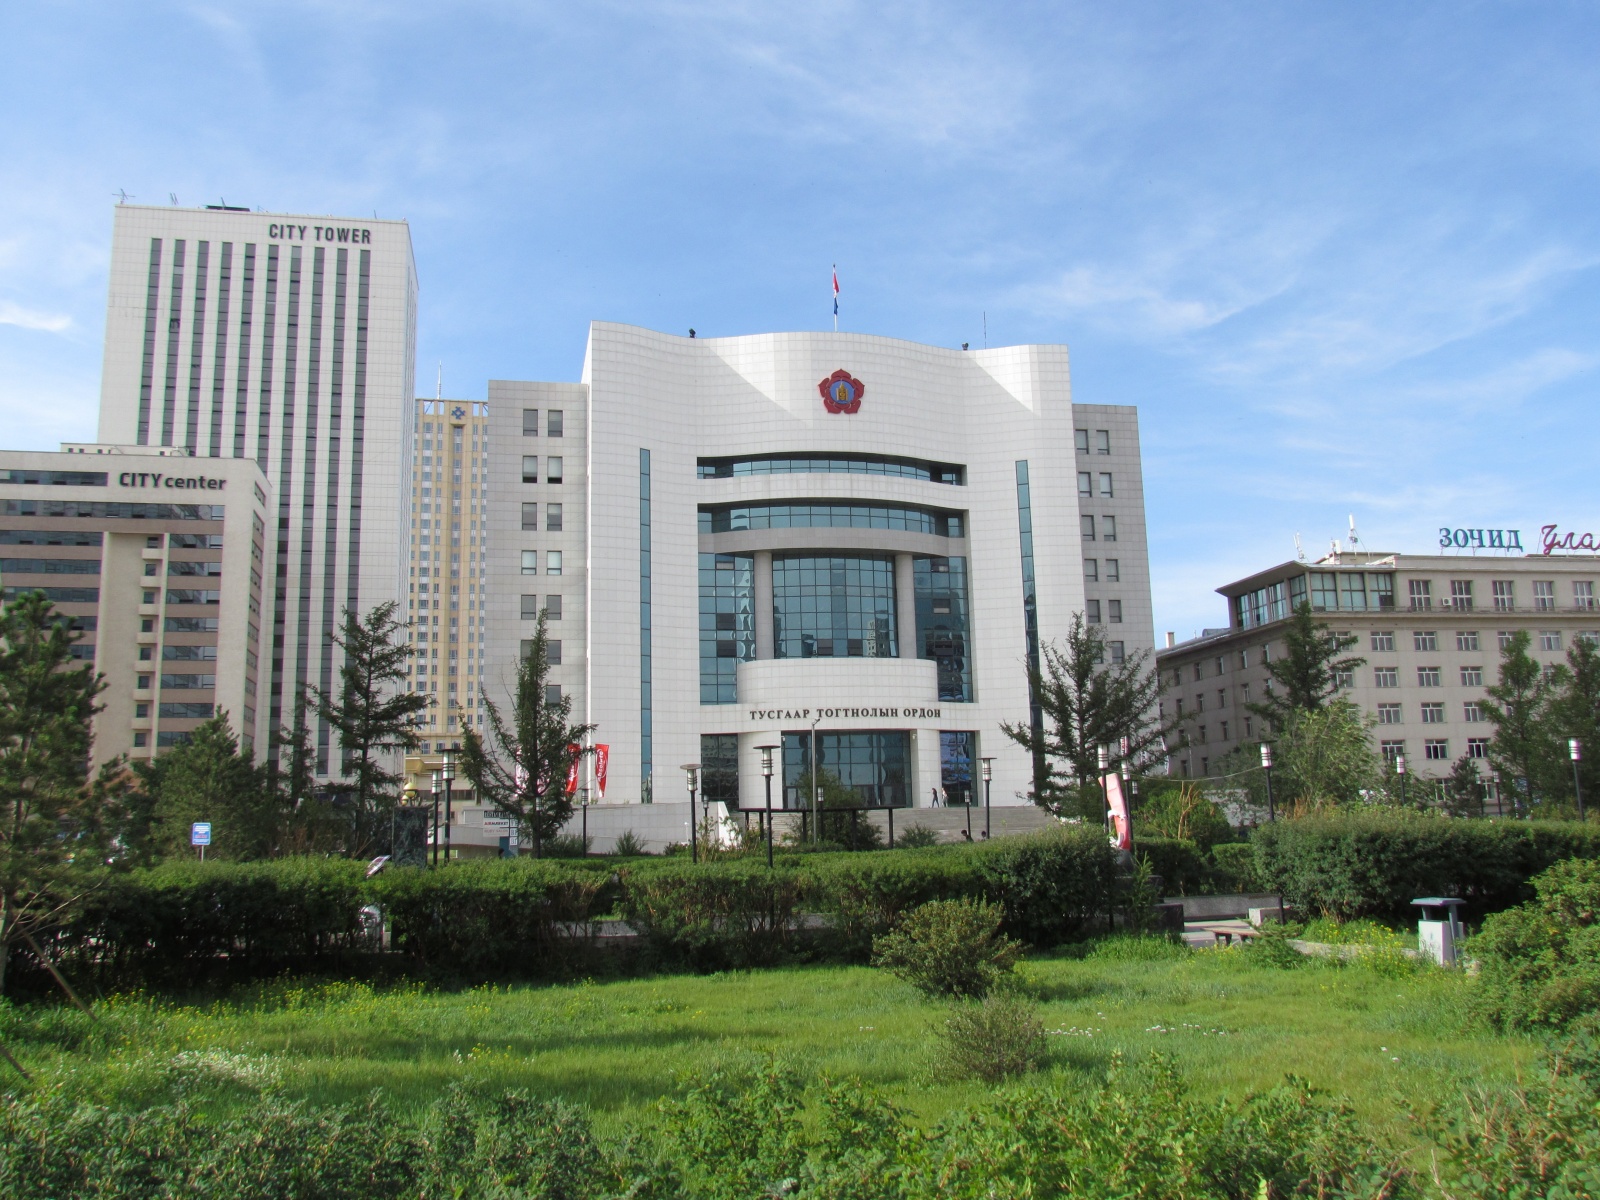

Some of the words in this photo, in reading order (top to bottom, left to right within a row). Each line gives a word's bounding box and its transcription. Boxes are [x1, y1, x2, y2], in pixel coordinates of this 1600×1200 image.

[269, 223, 307, 240] CITY
[314, 226, 371, 244] TOWER
[119, 472, 162, 488] CITY
[165, 475, 227, 490] center
[1439, 527, 1523, 552] ЗОЧИД
[750, 709, 810, 720] ТУСГААР
[816, 708, 899, 718] ТОГТНОЛЫН
[903, 708, 941, 718] ОРДОН
